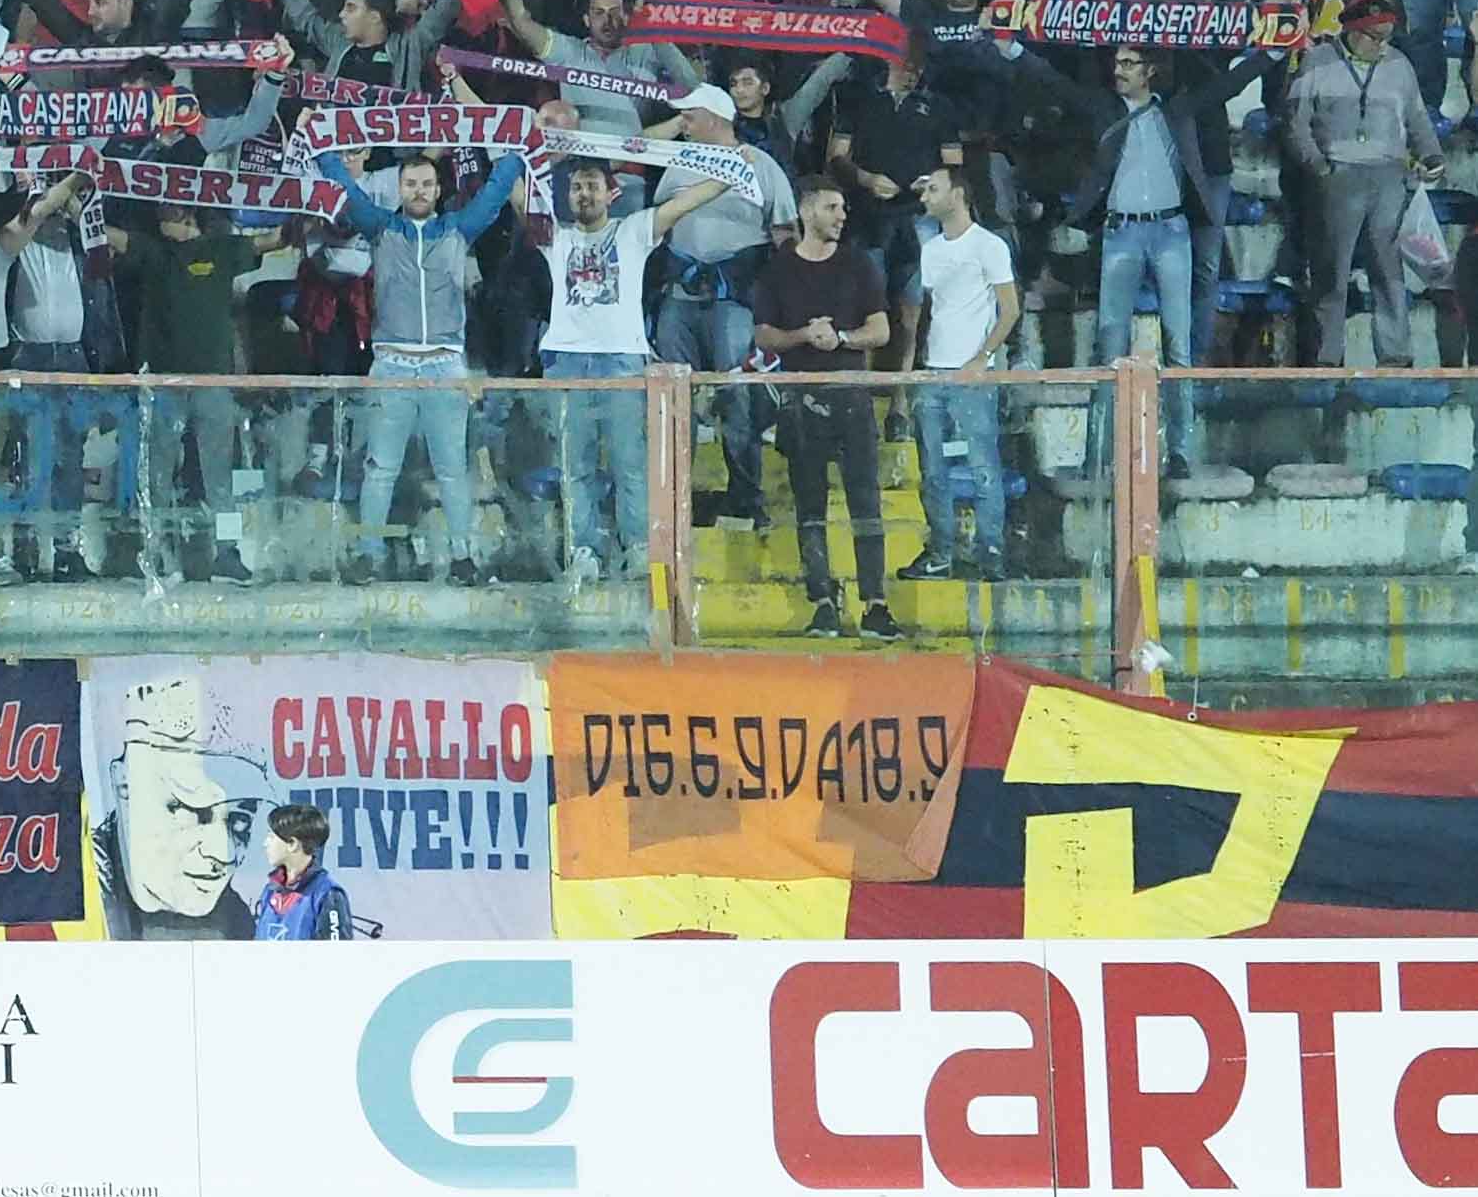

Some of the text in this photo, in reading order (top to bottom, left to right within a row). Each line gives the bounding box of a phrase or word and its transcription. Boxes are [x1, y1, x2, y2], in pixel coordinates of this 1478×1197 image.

[1042, 0, 1248, 34] MAGICA CASERTANA
[1101, 31, 1149, 43] VINCE
[1219, 34, 1239, 45] VA
[492, 57, 669, 102] FORZA CASERTANA
[18, 92, 146, 124] CASERTANA
[93, 123, 115, 135] NE
[272, 695, 532, 783] CAVALLO
